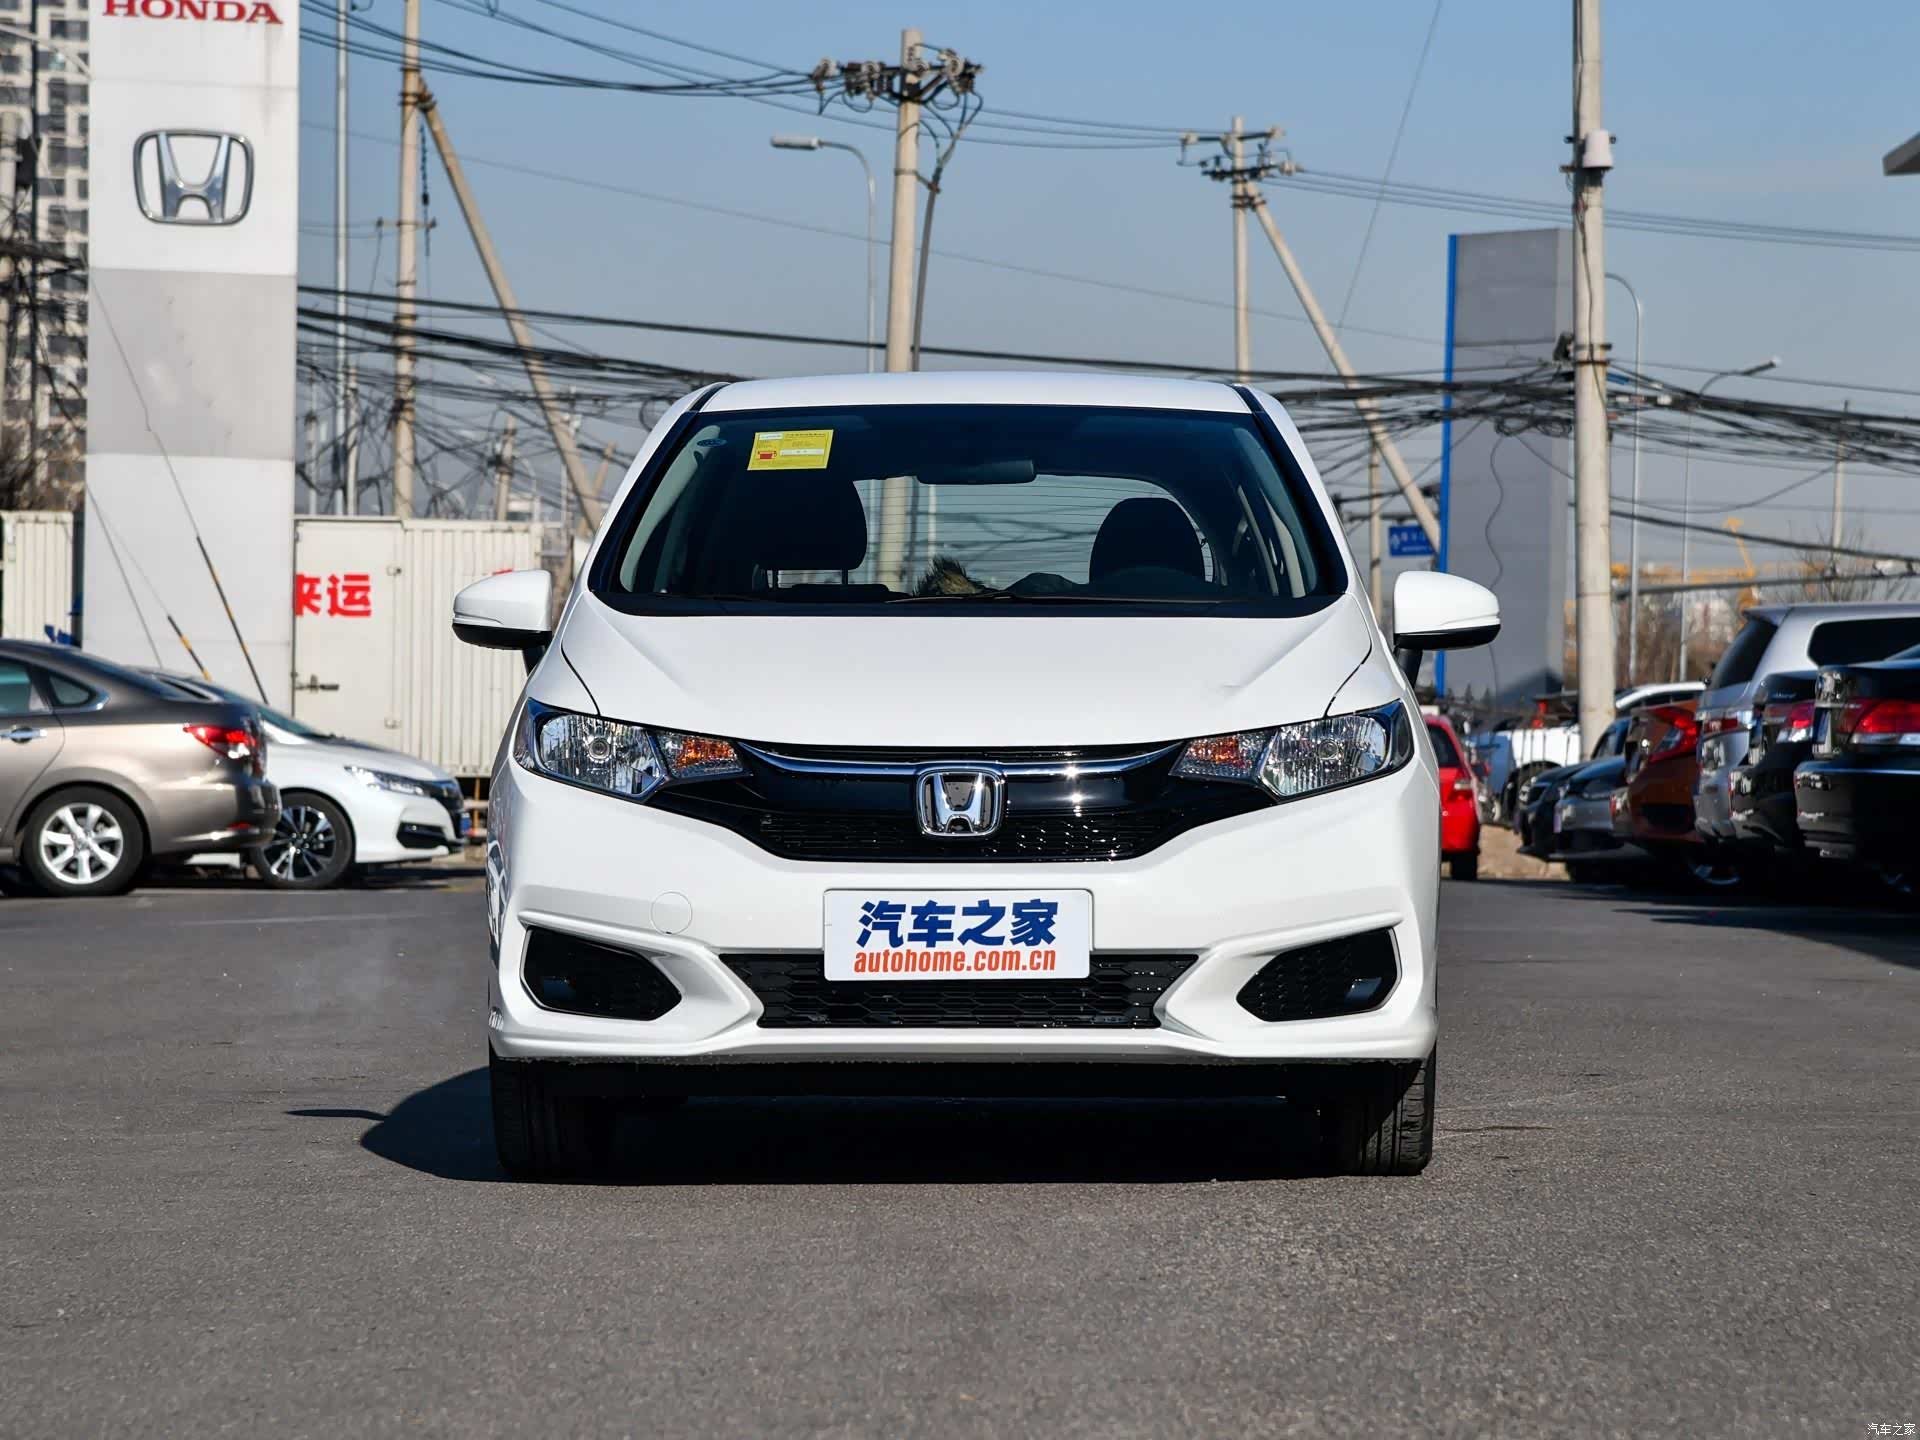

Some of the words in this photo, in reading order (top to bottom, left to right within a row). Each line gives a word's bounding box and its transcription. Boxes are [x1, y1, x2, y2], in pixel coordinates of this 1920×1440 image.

[103, 0, 283, 24] HONDA
[856, 899, 1058, 948] 汽车之家
[854, 950, 1056, 972] autohome.com.cn
